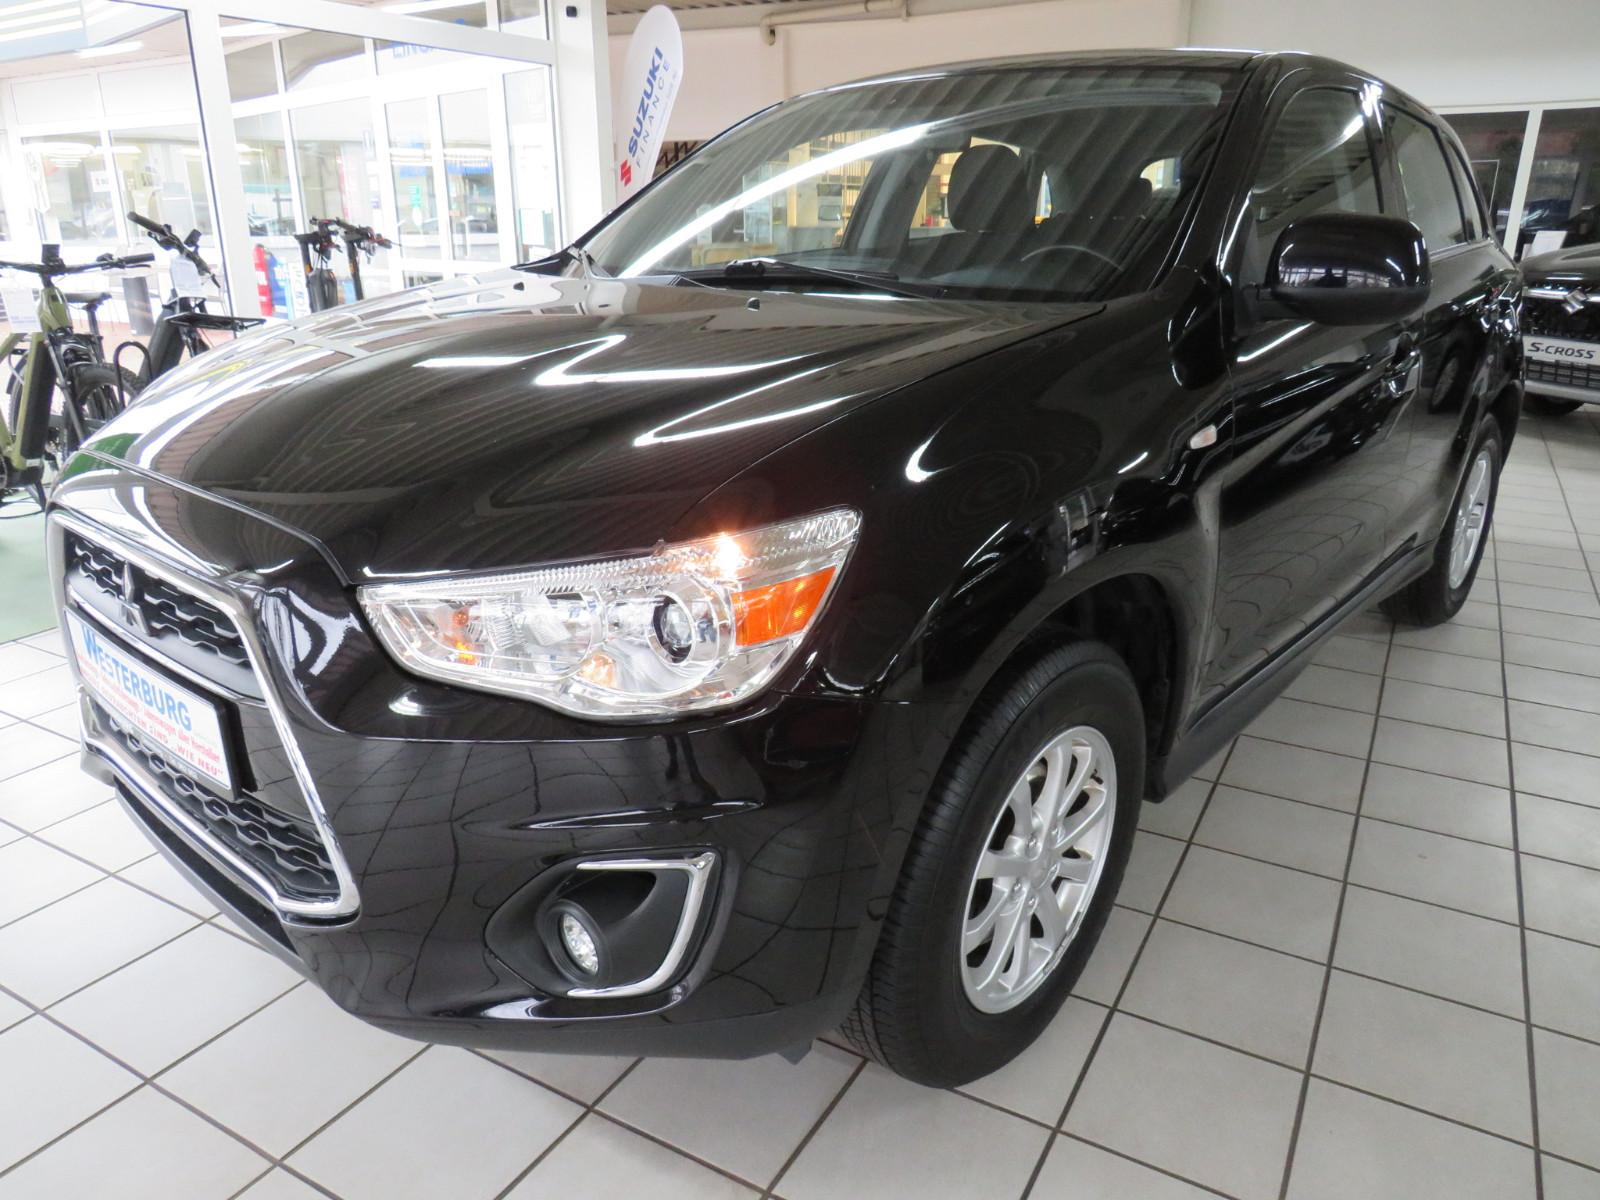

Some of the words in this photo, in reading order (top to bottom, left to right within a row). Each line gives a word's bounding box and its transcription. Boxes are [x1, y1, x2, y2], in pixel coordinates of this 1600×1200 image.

[628, 46, 663, 157] SUZUKI
[636, 59, 671, 168] FINANCE
[80, 623, 192, 731] WESTERBURG
